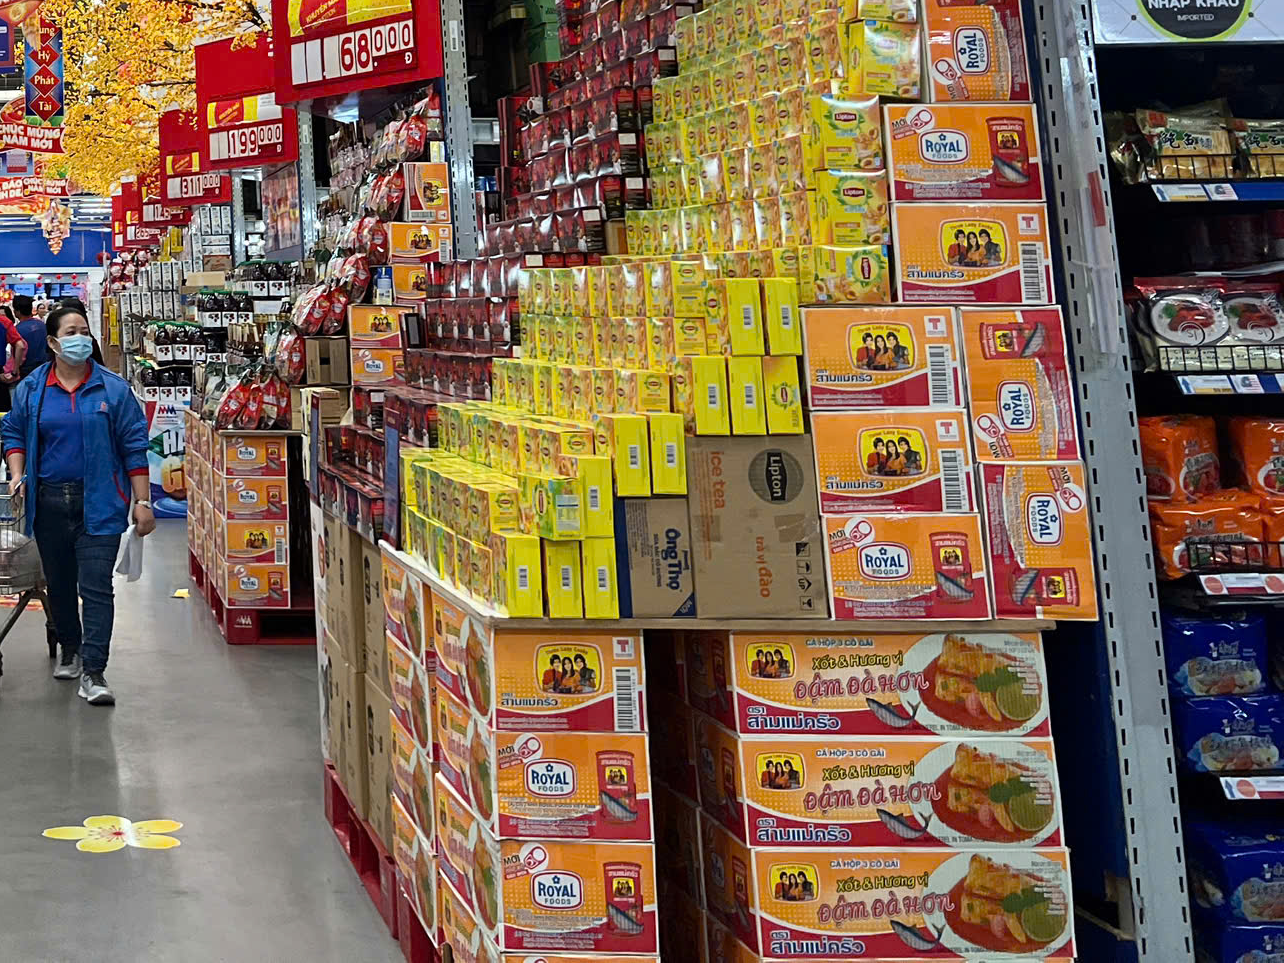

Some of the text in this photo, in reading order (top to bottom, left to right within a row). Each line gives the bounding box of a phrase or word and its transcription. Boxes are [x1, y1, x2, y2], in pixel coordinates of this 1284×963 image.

[1177, 13, 1215, 22] IMPORTED
[38, 26, 56, 37] ung
[33, 74, 55, 85] Phát
[925, 139, 963, 155] ROYAL
[1010, 387, 1025, 426] ROYAL
[710, 450, 726, 510] ice tea
[767, 455, 783, 498] Lipton
[1036, 498, 1052, 539] ROYAL
[865, 554, 904, 569] ROYAL
[850, 653, 891, 669] Hương
[531, 770, 570, 786] ROYAL
